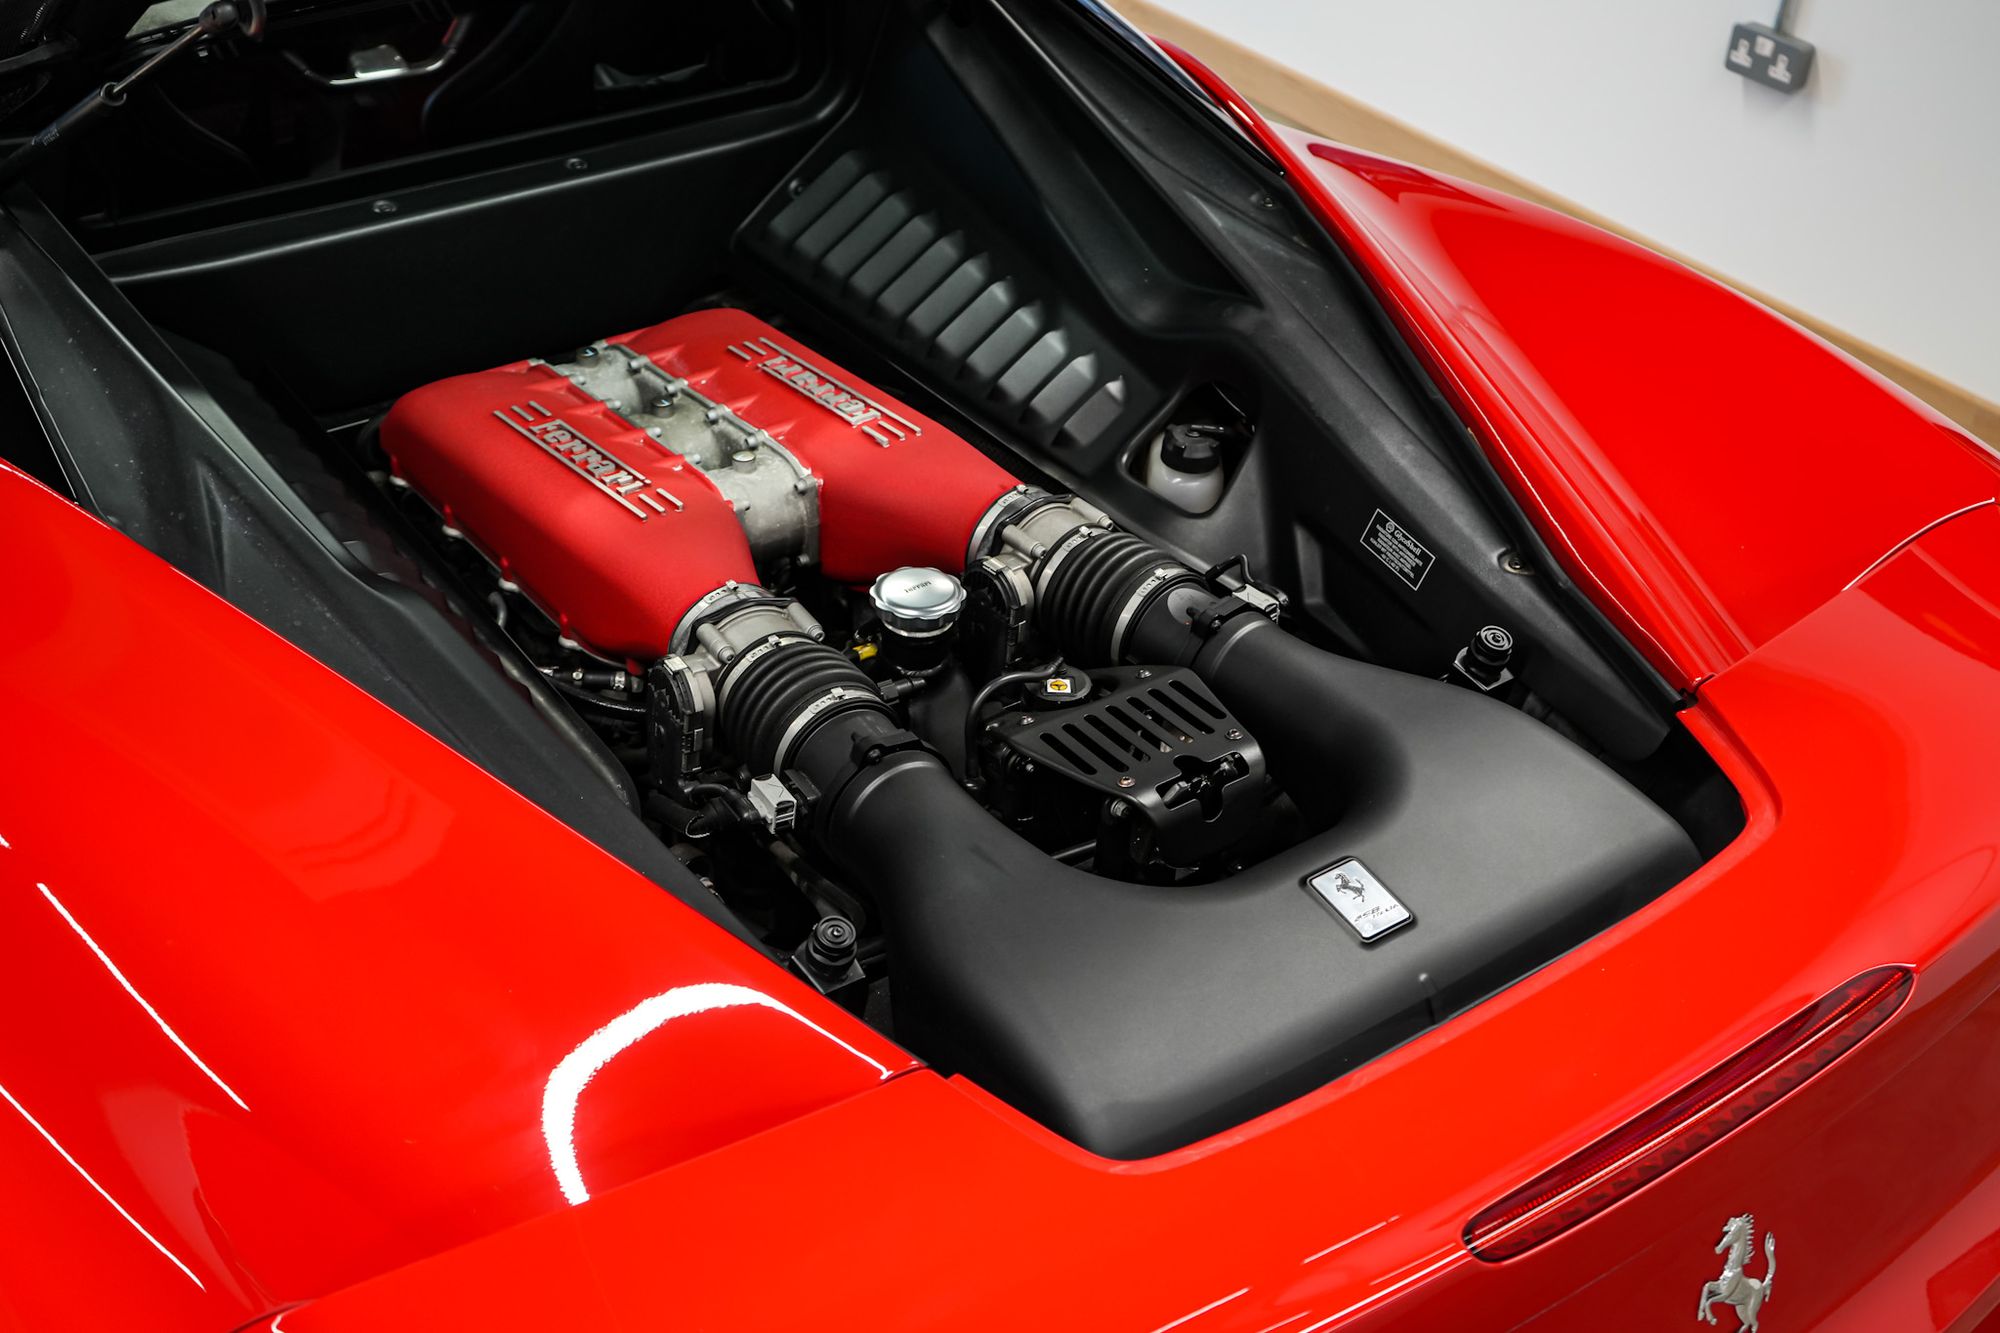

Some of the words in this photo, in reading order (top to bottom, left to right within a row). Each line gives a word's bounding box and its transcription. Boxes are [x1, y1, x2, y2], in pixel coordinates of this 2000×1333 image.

[757, 355, 881, 427] Ferrari
[529, 418, 652, 497] Ferrari
[1393, 529, 1421, 556] GlycoShell
